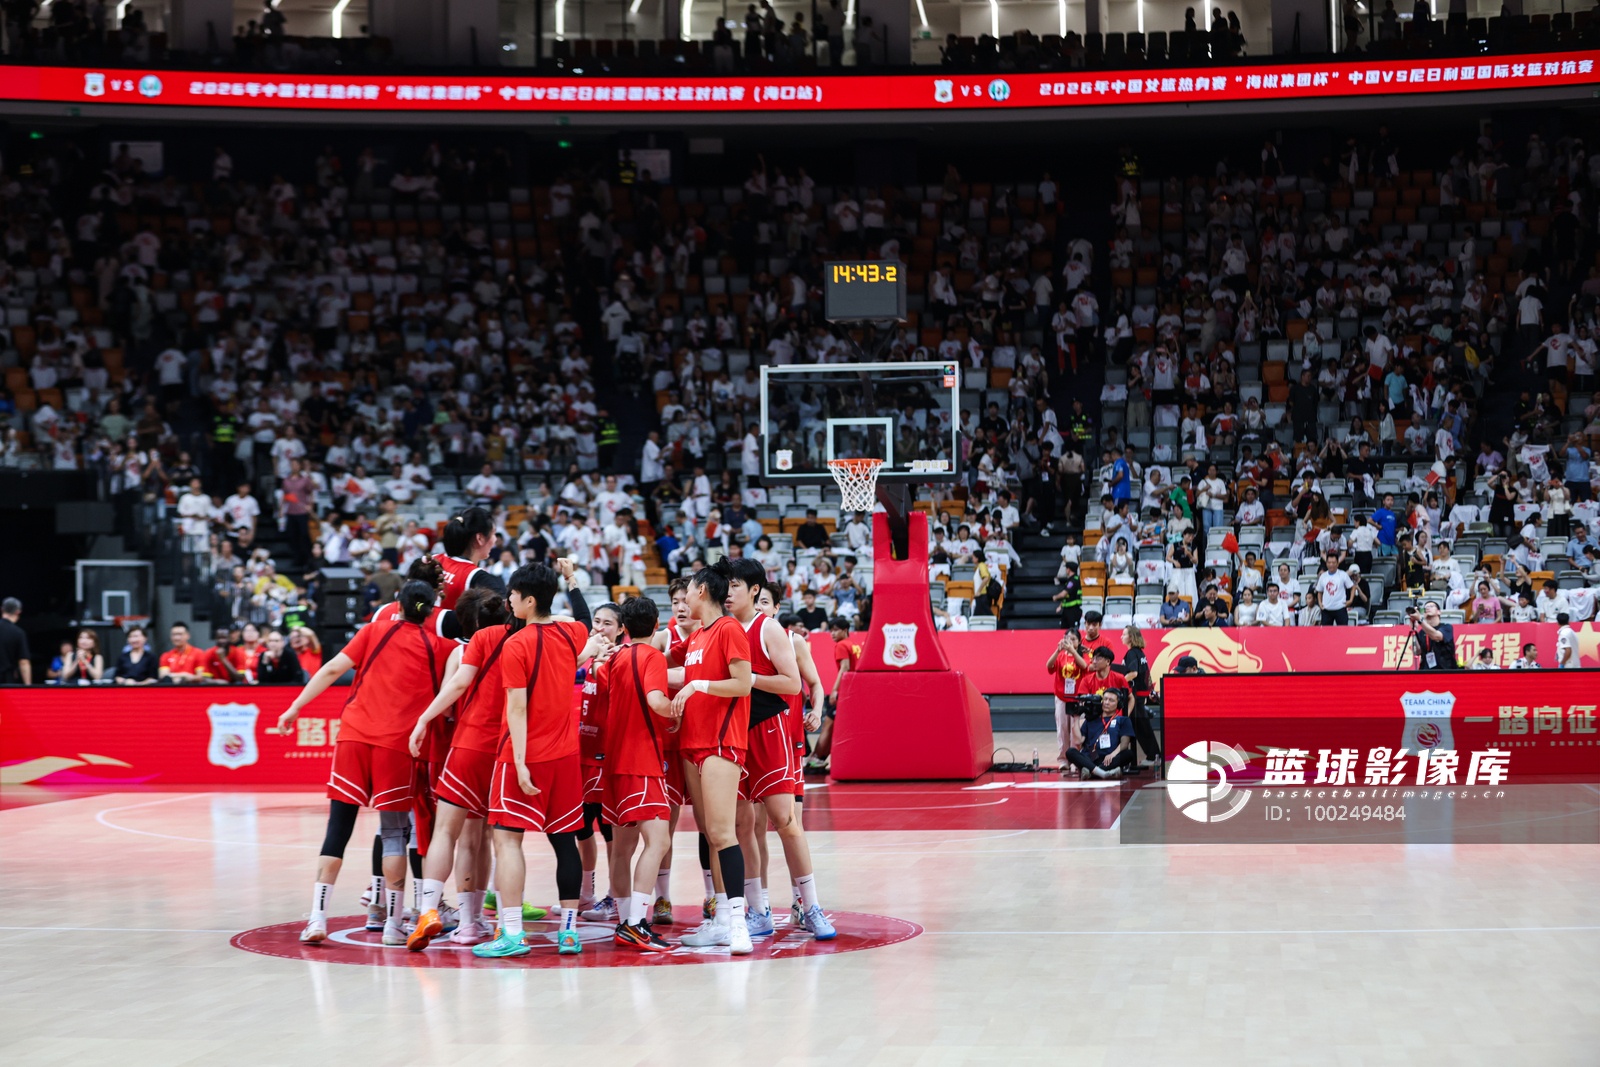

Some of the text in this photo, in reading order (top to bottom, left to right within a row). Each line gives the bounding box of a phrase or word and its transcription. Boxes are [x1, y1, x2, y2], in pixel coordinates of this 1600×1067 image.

[960, 84, 982, 97] VS
[833, 264, 897, 283] 14:43.2
[582, 700, 589, 716] 5
[1427, 698, 1451, 706] CHINA
